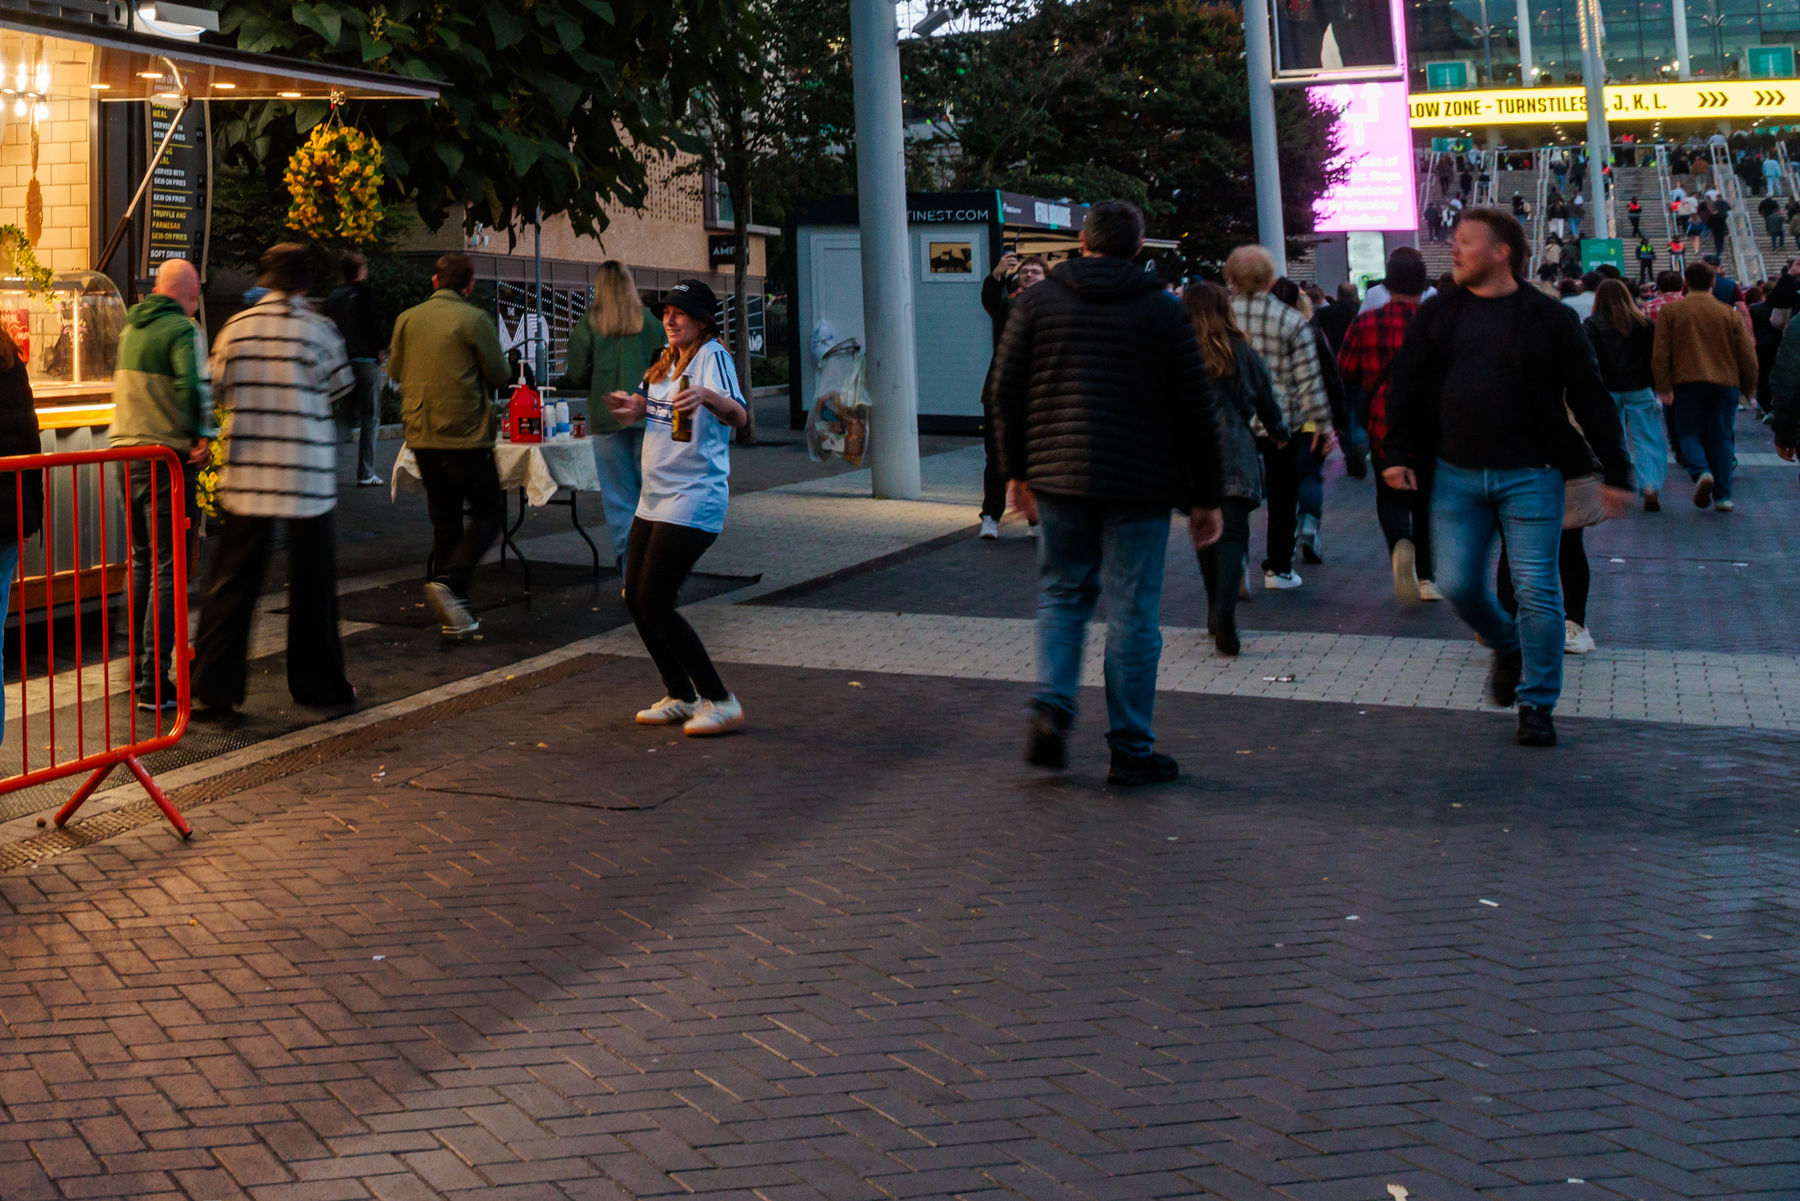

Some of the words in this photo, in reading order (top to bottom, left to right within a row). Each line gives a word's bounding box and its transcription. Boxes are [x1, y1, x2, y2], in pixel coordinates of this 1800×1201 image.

[1444, 99, 1481, 117] ZONE
[1496, 95, 1587, 115] TURNSTILES
[1613, 94, 1629, 112] J,
[1633, 93, 1650, 112] K,
[1653, 92, 1667, 110] L.
[150, 249, 166, 258] SOFT
